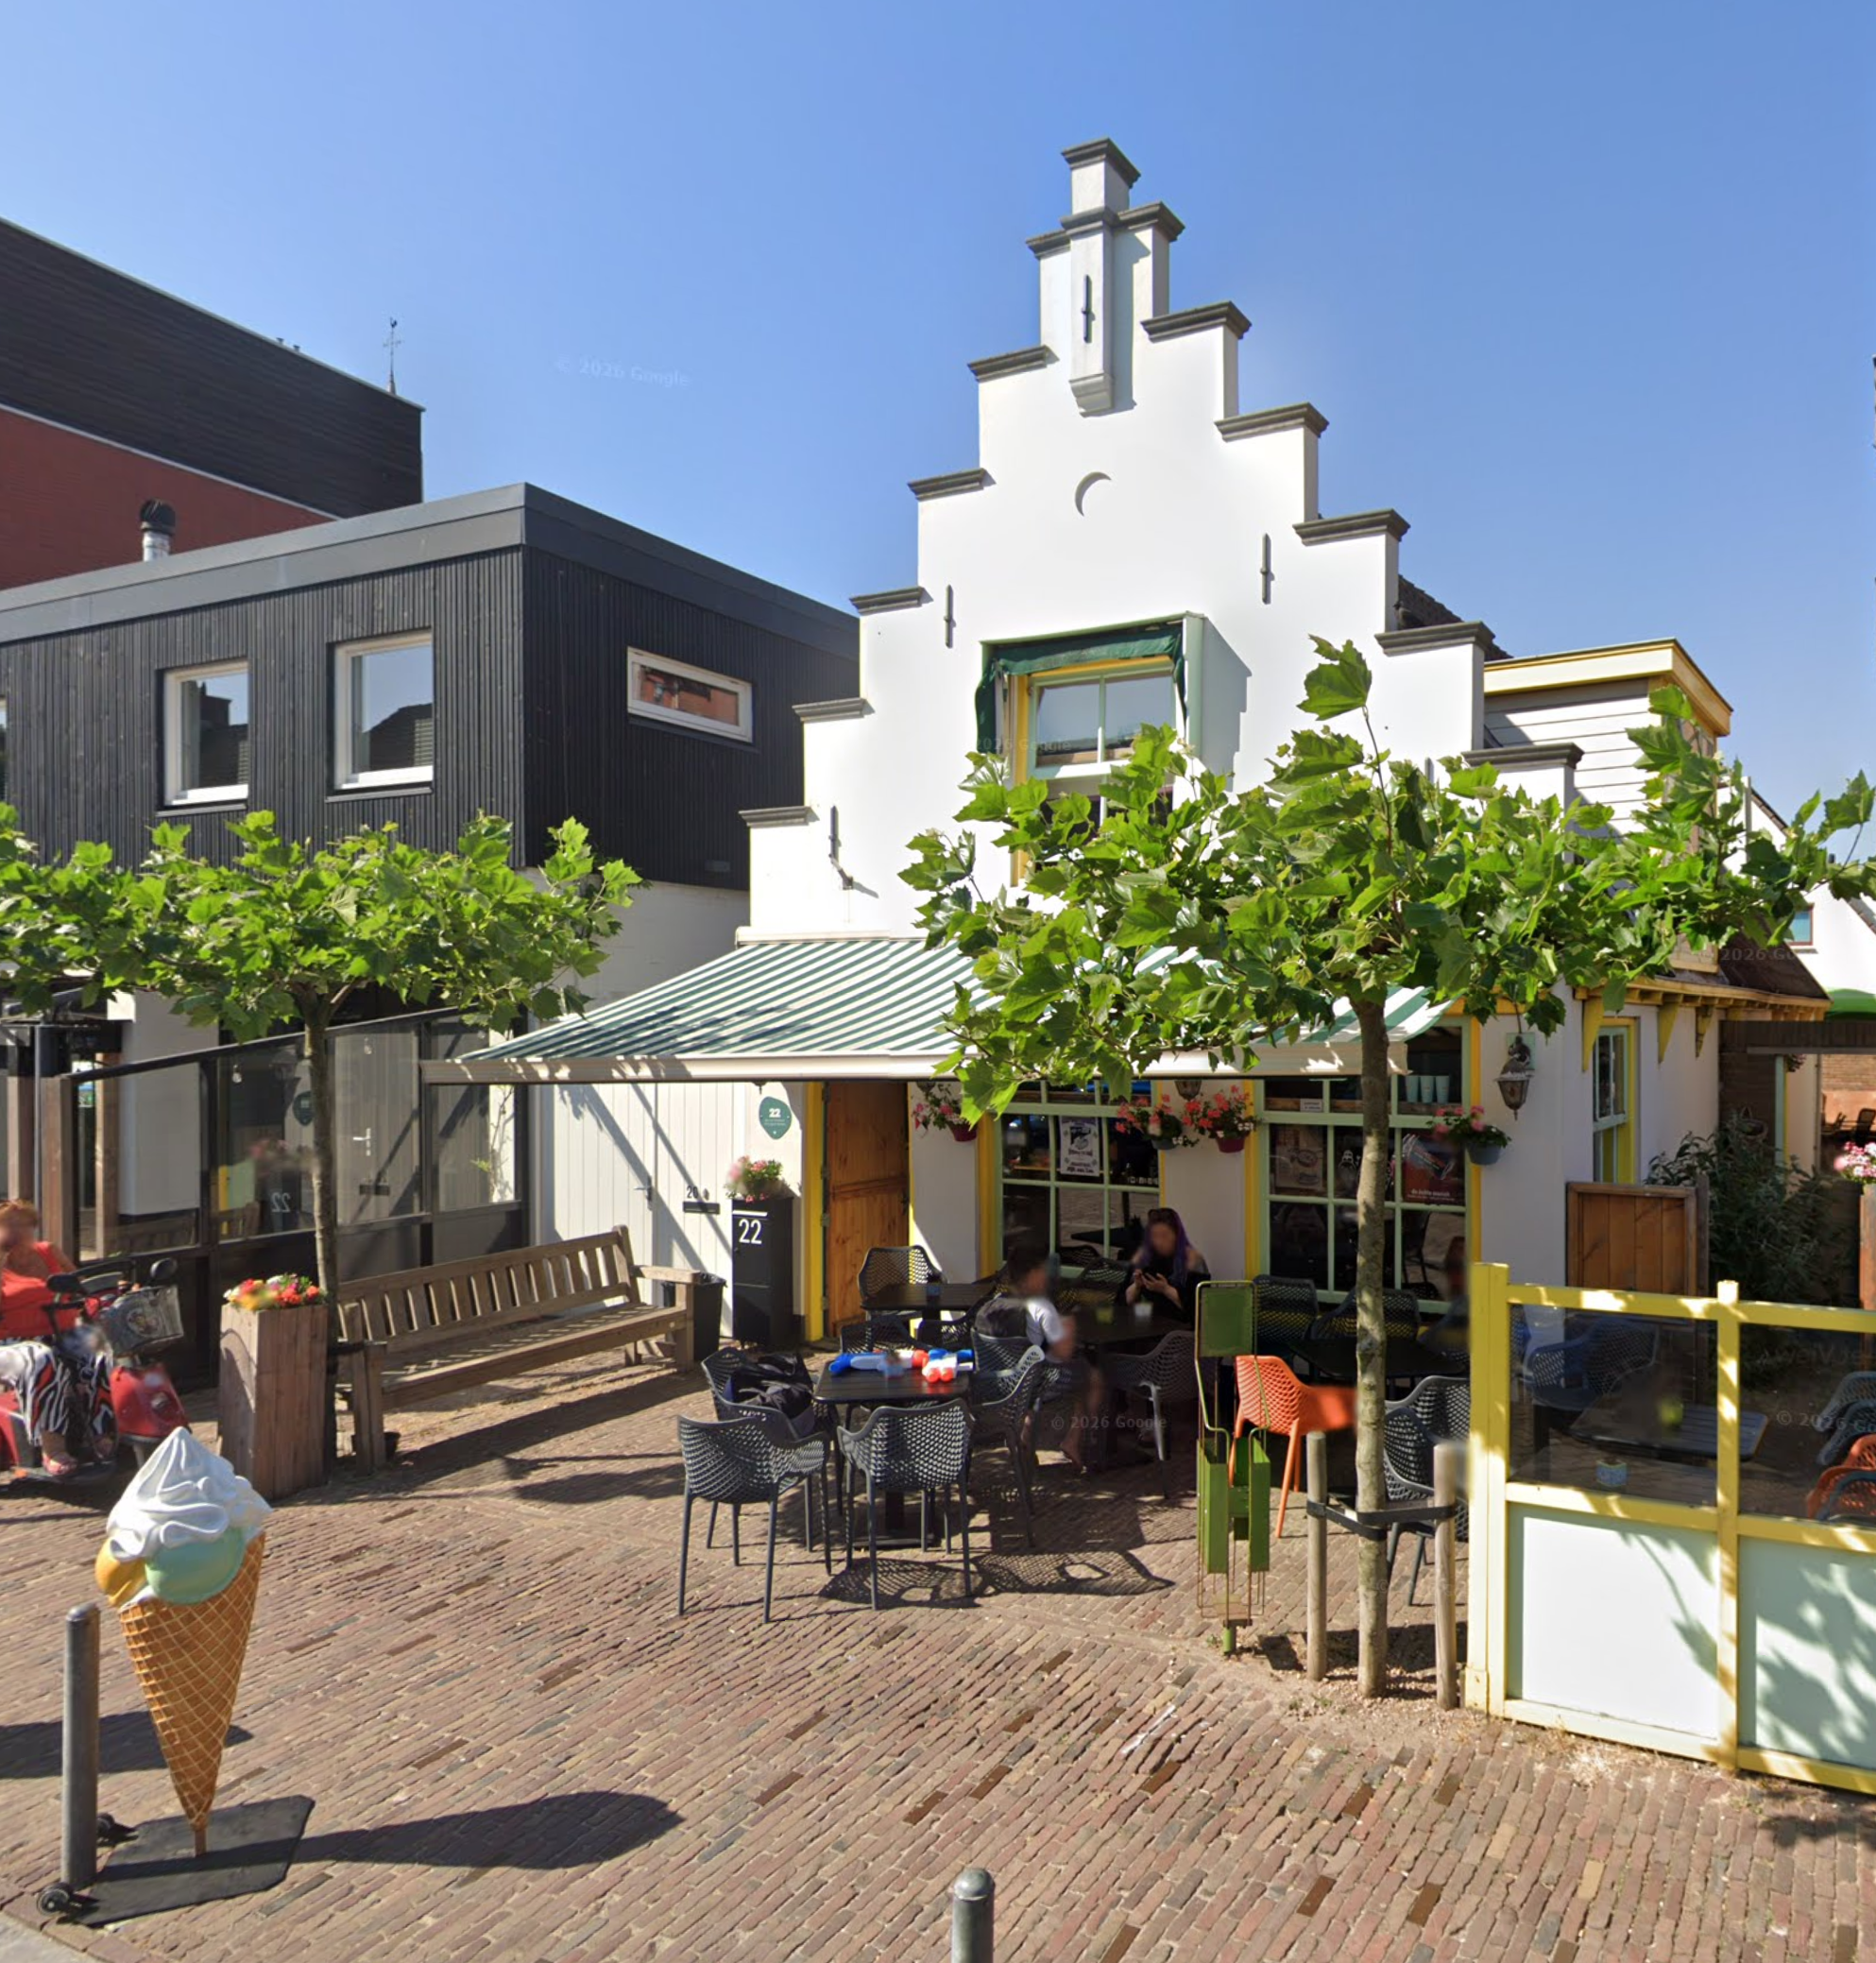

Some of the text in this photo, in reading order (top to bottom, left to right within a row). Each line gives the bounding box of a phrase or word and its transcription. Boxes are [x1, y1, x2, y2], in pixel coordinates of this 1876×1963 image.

[768, 1107, 781, 1118] 22
[686, 1186, 699, 1199] 20
[738, 1218, 762, 1245] 22
